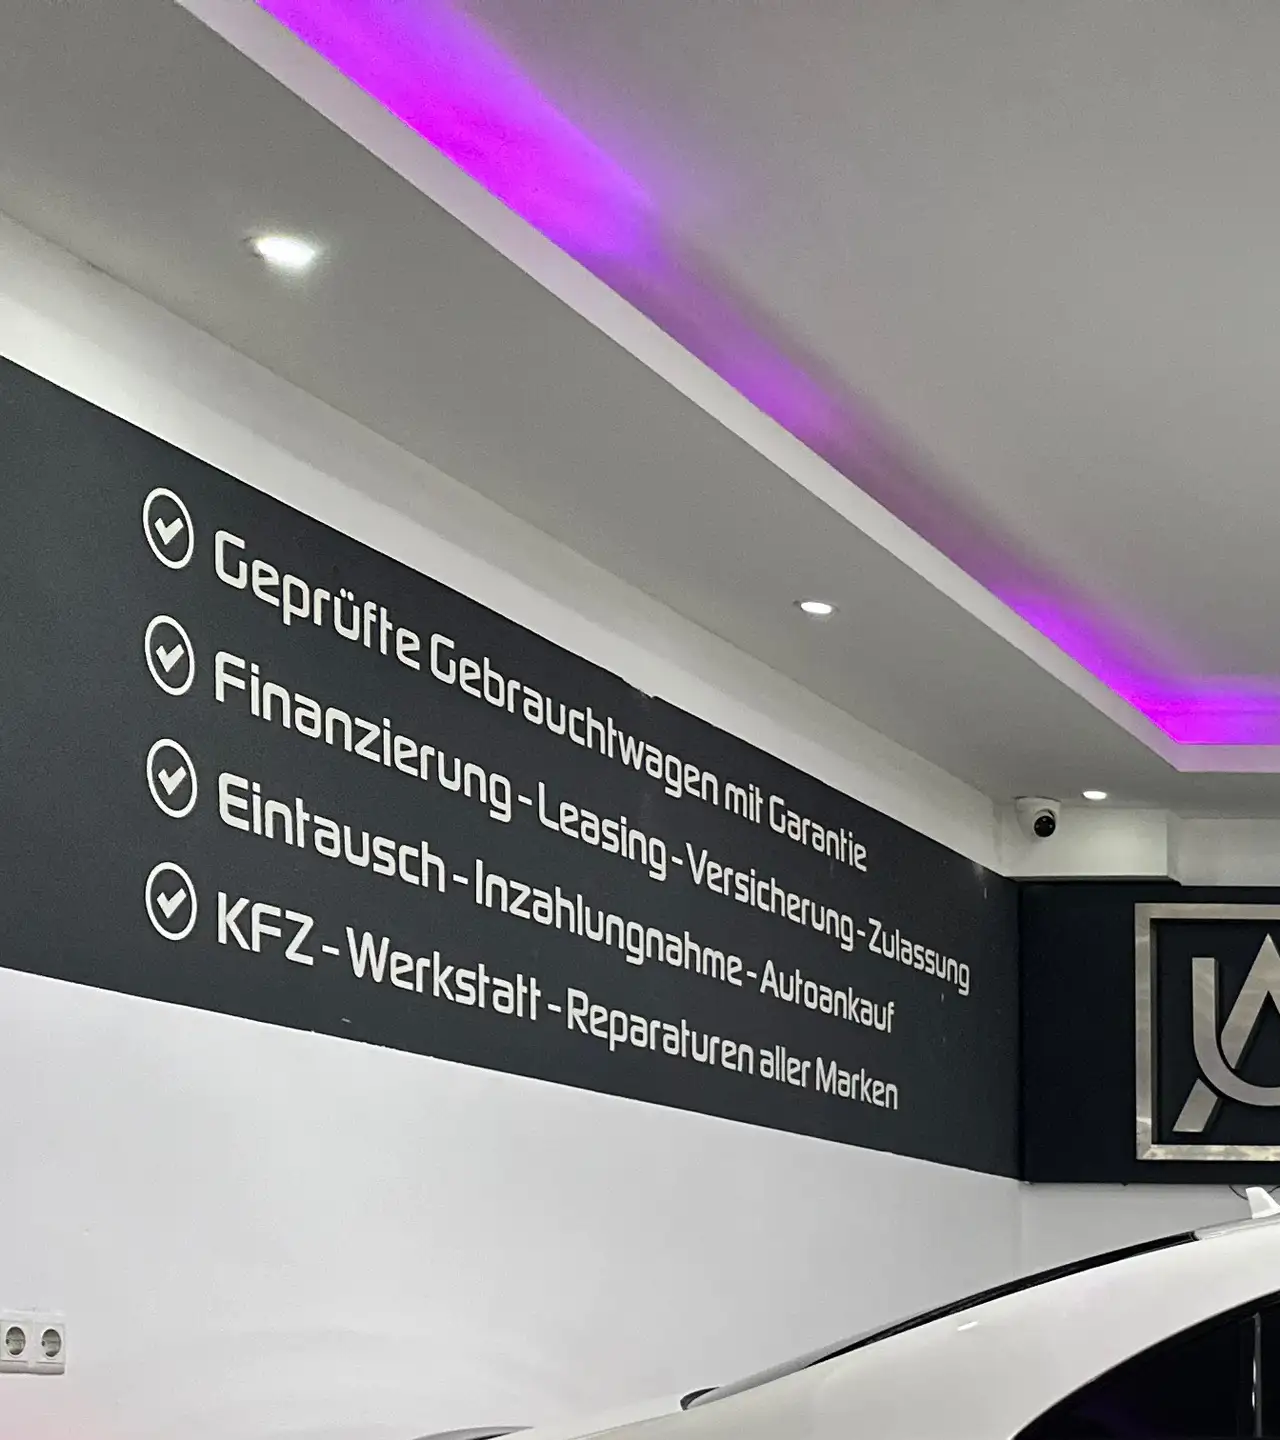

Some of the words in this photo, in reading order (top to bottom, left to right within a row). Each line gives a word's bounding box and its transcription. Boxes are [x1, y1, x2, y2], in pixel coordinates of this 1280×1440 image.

[214, 530, 420, 671] Geprüfte
[430, 633, 719, 806] Gebrauchtwagen
[724, 783, 764, 824] mit
[769, 795, 867, 872] Garantie
[214, 651, 512, 823] Finanzierung
[538, 782, 667, 882] Leasing
[686, 843, 854, 952] Versicherung
[868, 917, 970, 996] Zulassung
[217, 891, 314, 966] KFZ
[345, 926, 542, 1021] Werkstatt
[567, 987, 754, 1075] Reparaturen
[759, 1045, 811, 1088] aller
[815, 1056, 898, 1110] Marken
[218, 772, 446, 893] Eintausch
[475, 858, 743, 987] Inzahlungnahme
[760, 959, 895, 1033] Autoankauf
